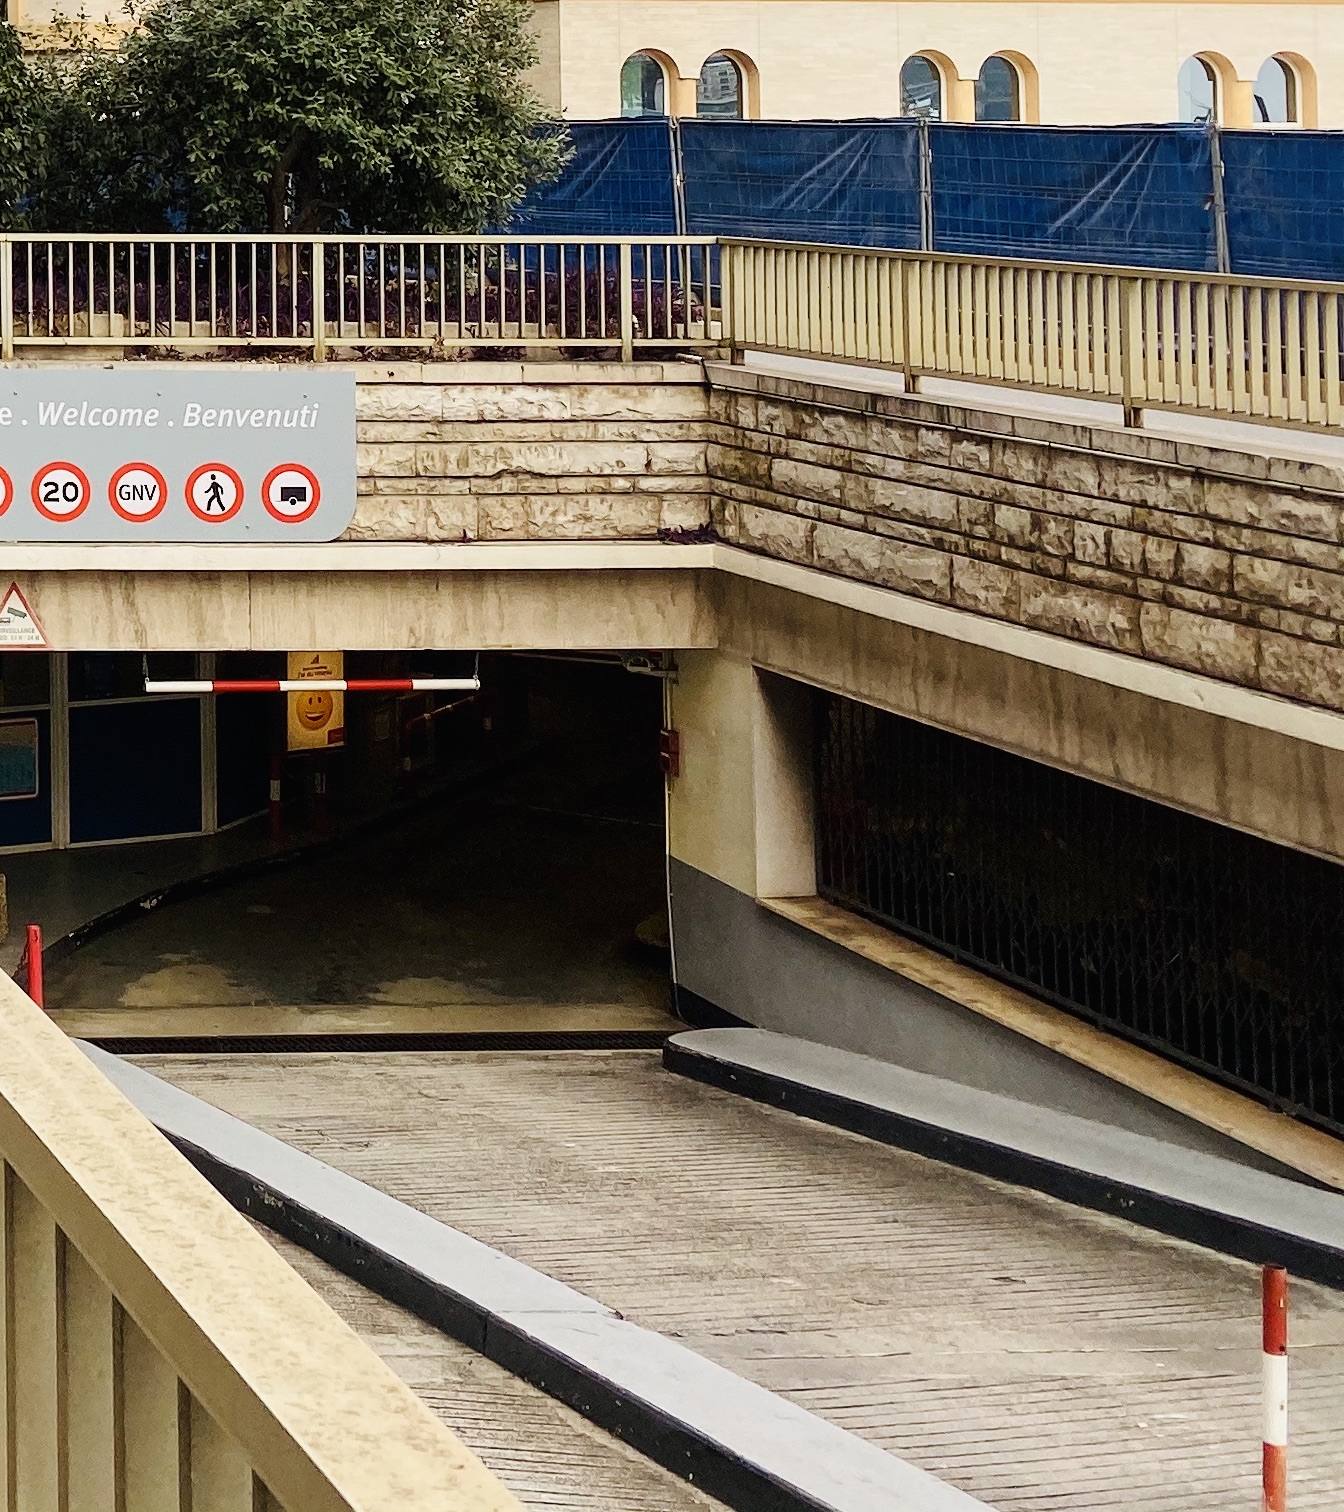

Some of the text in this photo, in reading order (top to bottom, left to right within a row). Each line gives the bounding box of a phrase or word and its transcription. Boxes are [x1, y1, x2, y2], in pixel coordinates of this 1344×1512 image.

[38, 400, 160, 428] Welcome
[182, 402, 320, 428] Benvenuti
[43, 480, 79, 503] 20
[118, 484, 157, 501] GNV
